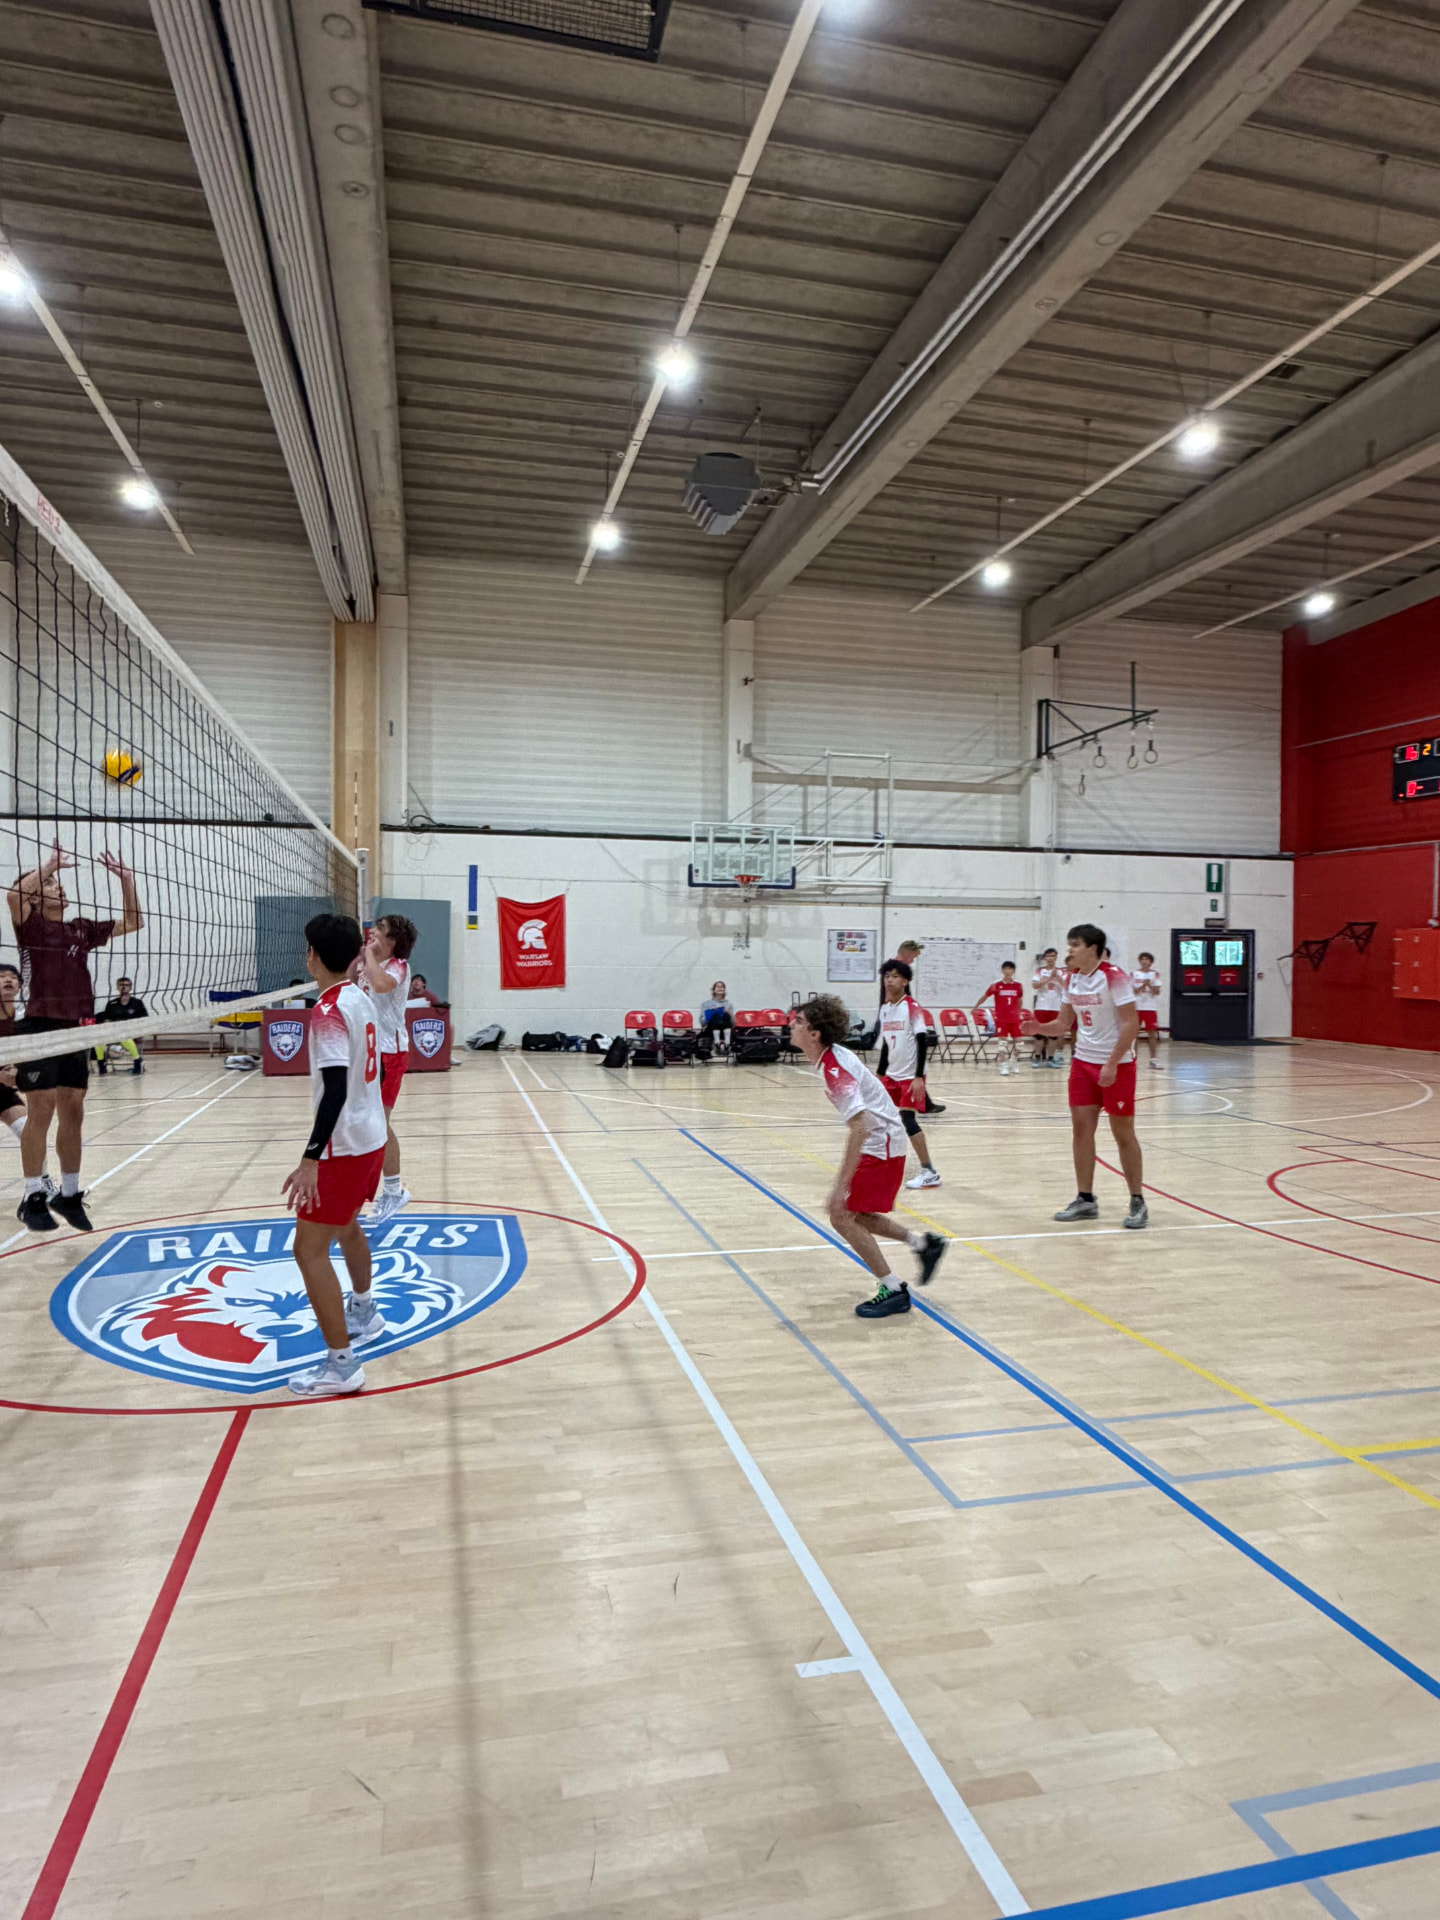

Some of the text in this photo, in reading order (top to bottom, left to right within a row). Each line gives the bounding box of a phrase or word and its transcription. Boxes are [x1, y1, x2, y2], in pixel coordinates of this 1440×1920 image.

[1422, 744, 1431, 755] 2
[516, 960, 552, 968] WARRIORS
[1080, 1010, 1092, 1026] 16
[271, 1022, 301, 1034] RAIDERS
[415, 1021, 443, 1032] RAIDERS
[891, 1035, 896, 1049] 7
[364, 1021, 377, 1084] 8
[147, 1223, 479, 1263] RAIRS
